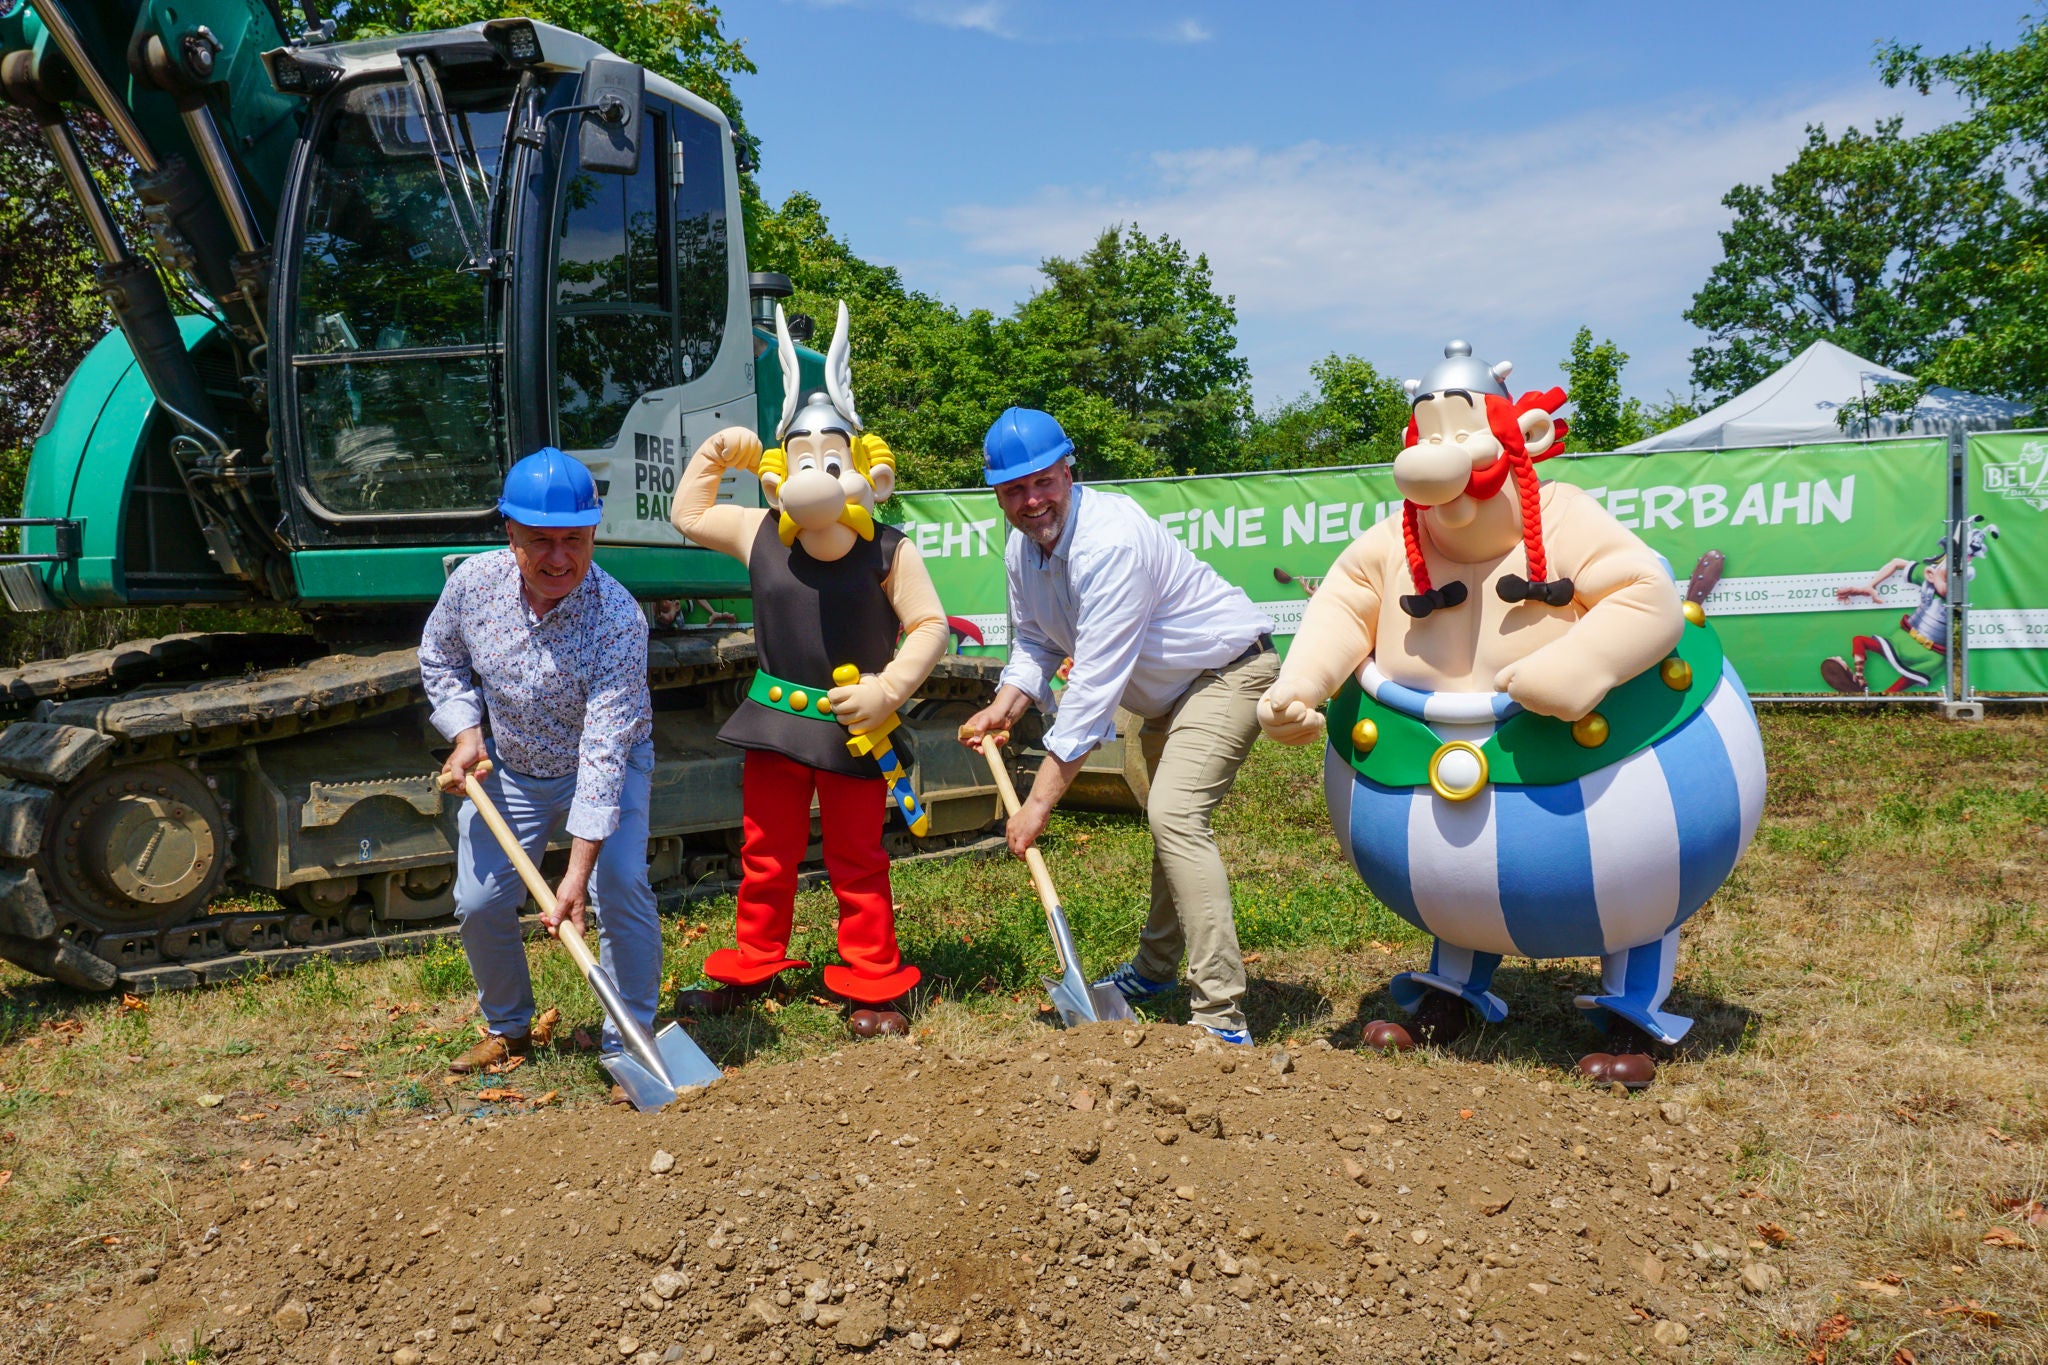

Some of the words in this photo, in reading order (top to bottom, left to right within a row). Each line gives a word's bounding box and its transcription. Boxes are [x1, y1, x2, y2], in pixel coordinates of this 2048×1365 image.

[649, 435, 675, 465] RE
[635, 463, 675, 494] PRO
[636, 493, 674, 523] BAU
[1282, 500, 1405, 547] NEU
[1745, 590, 1769, 601] LOS
[1787, 588, 1819, 600] 2027
[1878, 584, 1898, 596] OS
[1283, 612, 1303, 623] LOS
[1979, 624, 2005, 635] LOS
